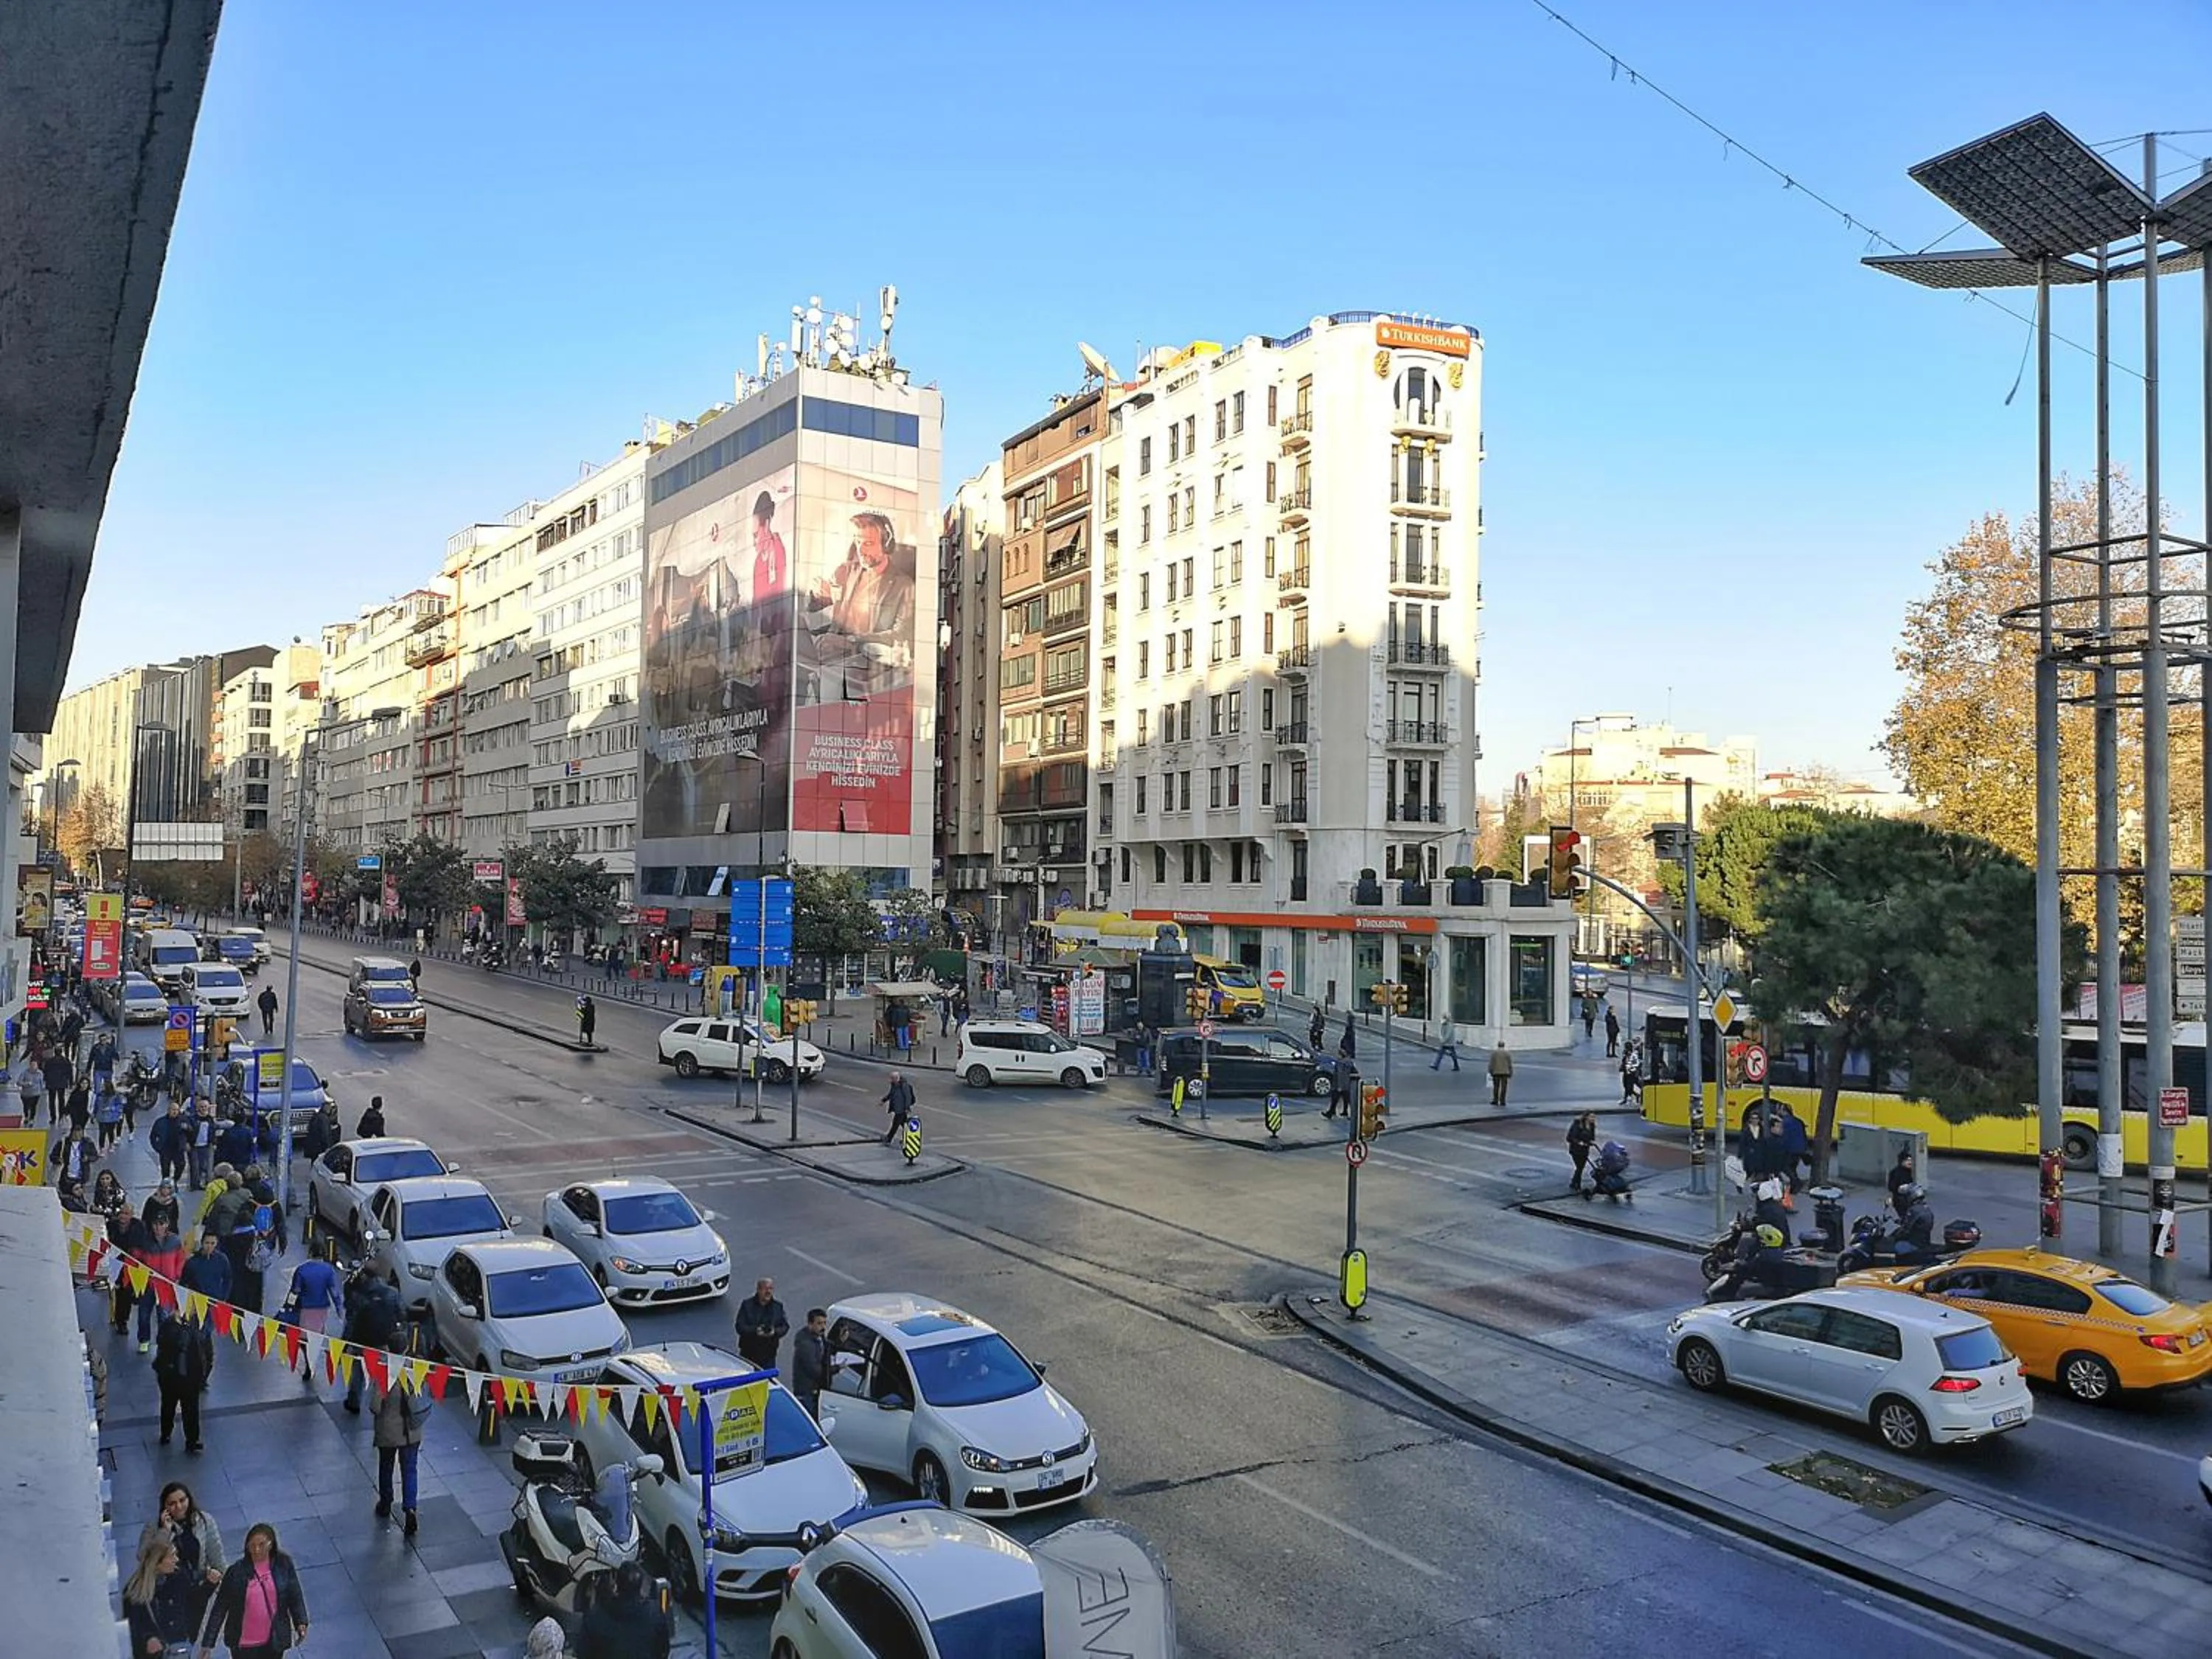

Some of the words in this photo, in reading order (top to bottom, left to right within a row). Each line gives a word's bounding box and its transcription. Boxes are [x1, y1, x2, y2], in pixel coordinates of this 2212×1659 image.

[814, 735, 862, 748] BUSINESS
[863, 739, 895, 751] CLASS
[808, 748, 899, 763] AYRICALIKLARIYLA
[831, 773, 876, 788] HİSSEDİN
